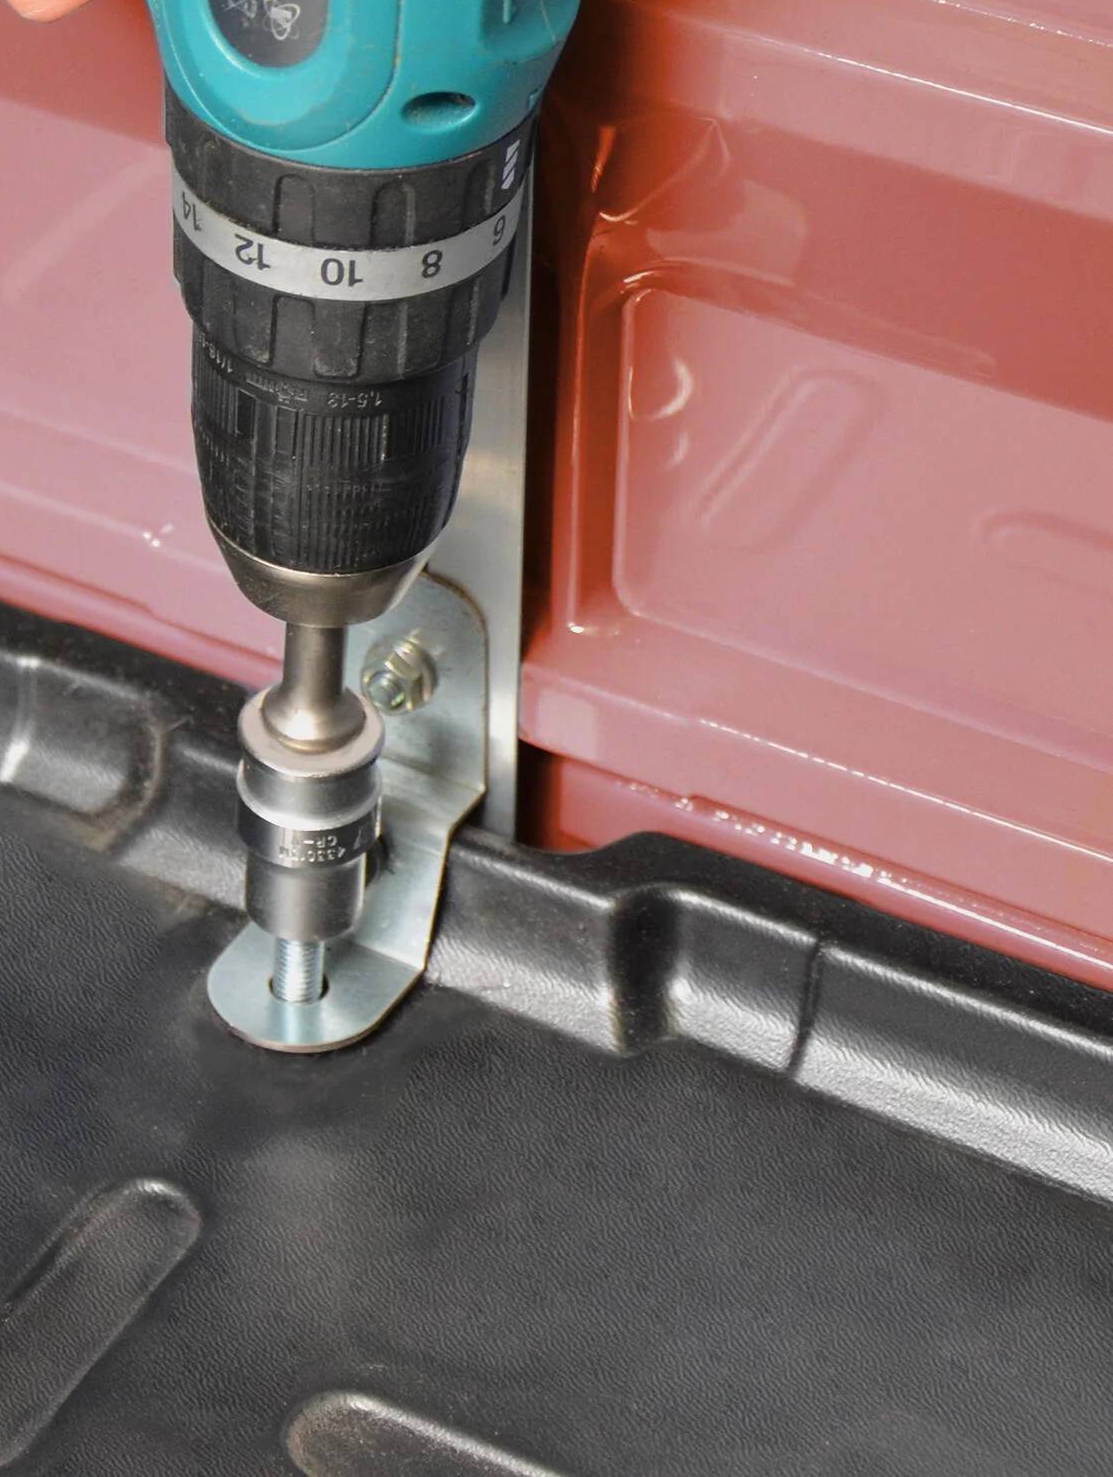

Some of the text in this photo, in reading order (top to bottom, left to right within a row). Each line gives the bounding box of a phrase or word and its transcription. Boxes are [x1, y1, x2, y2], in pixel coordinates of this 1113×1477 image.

[181, 191, 202, 232] 14
[233, 232, 271, 272] 12
[320, 258, 364, 288] 10
[421, 249, 443, 279] 8
